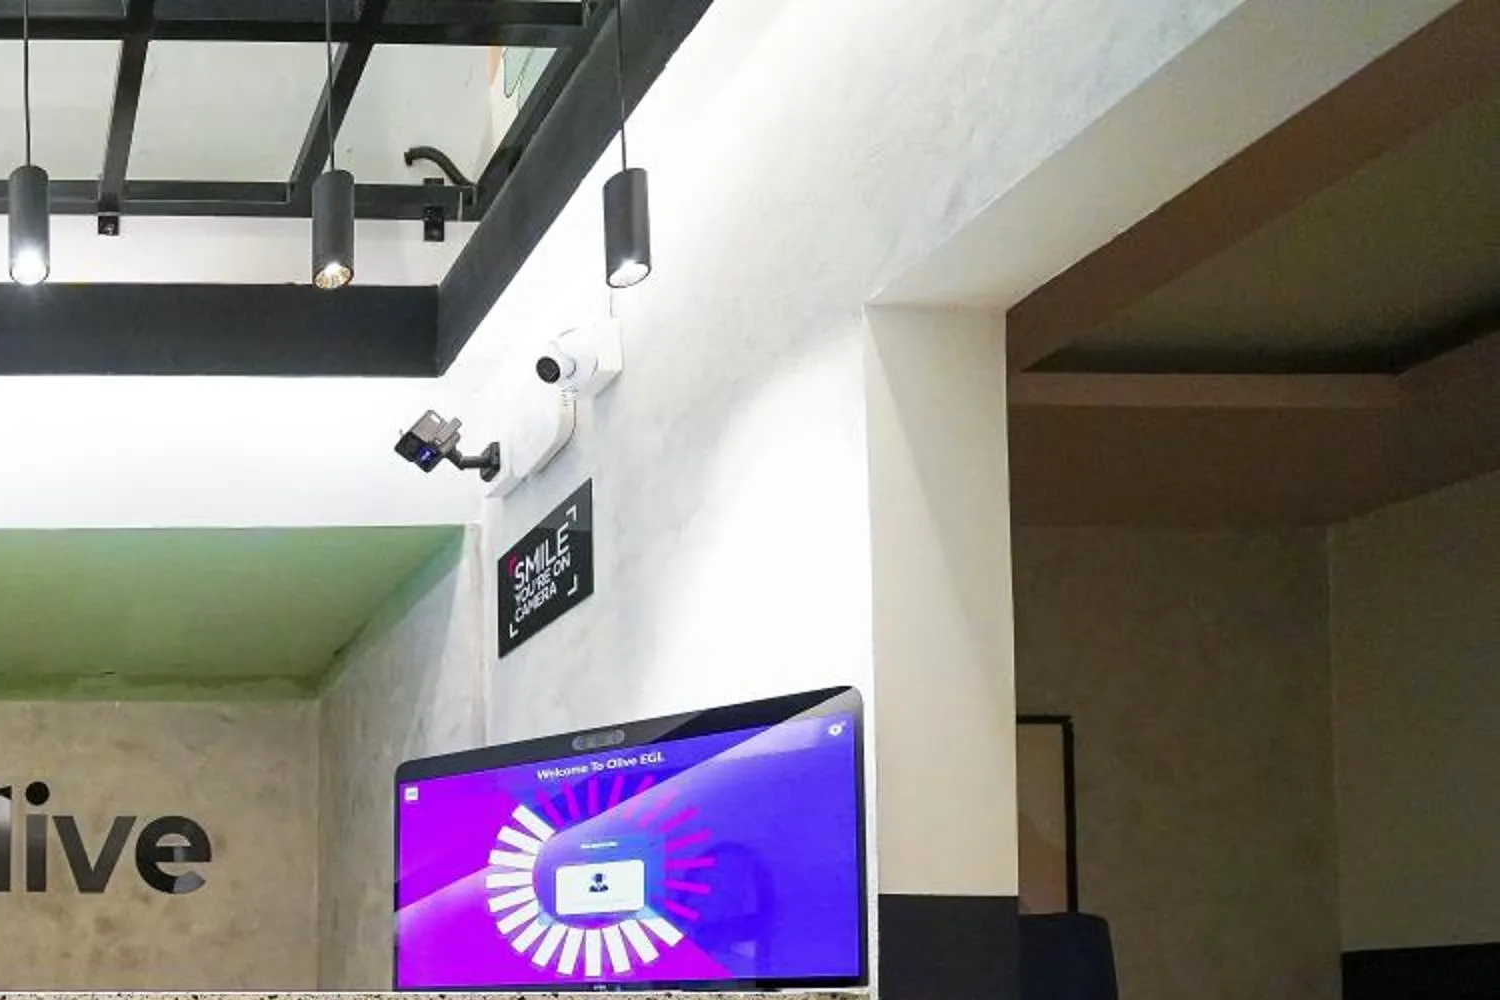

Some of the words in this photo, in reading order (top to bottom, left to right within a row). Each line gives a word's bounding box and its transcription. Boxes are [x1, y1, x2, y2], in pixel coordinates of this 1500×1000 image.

[514, 522, 570, 591] SMILE
[514, 567, 551, 604] YOU'RE
[553, 552, 571, 576] ON
[514, 582, 557, 622] CAMERA
[536, 764, 589, 780] Welcome
[590, 761, 605, 771] To
[606, 756, 638, 769] Olive
